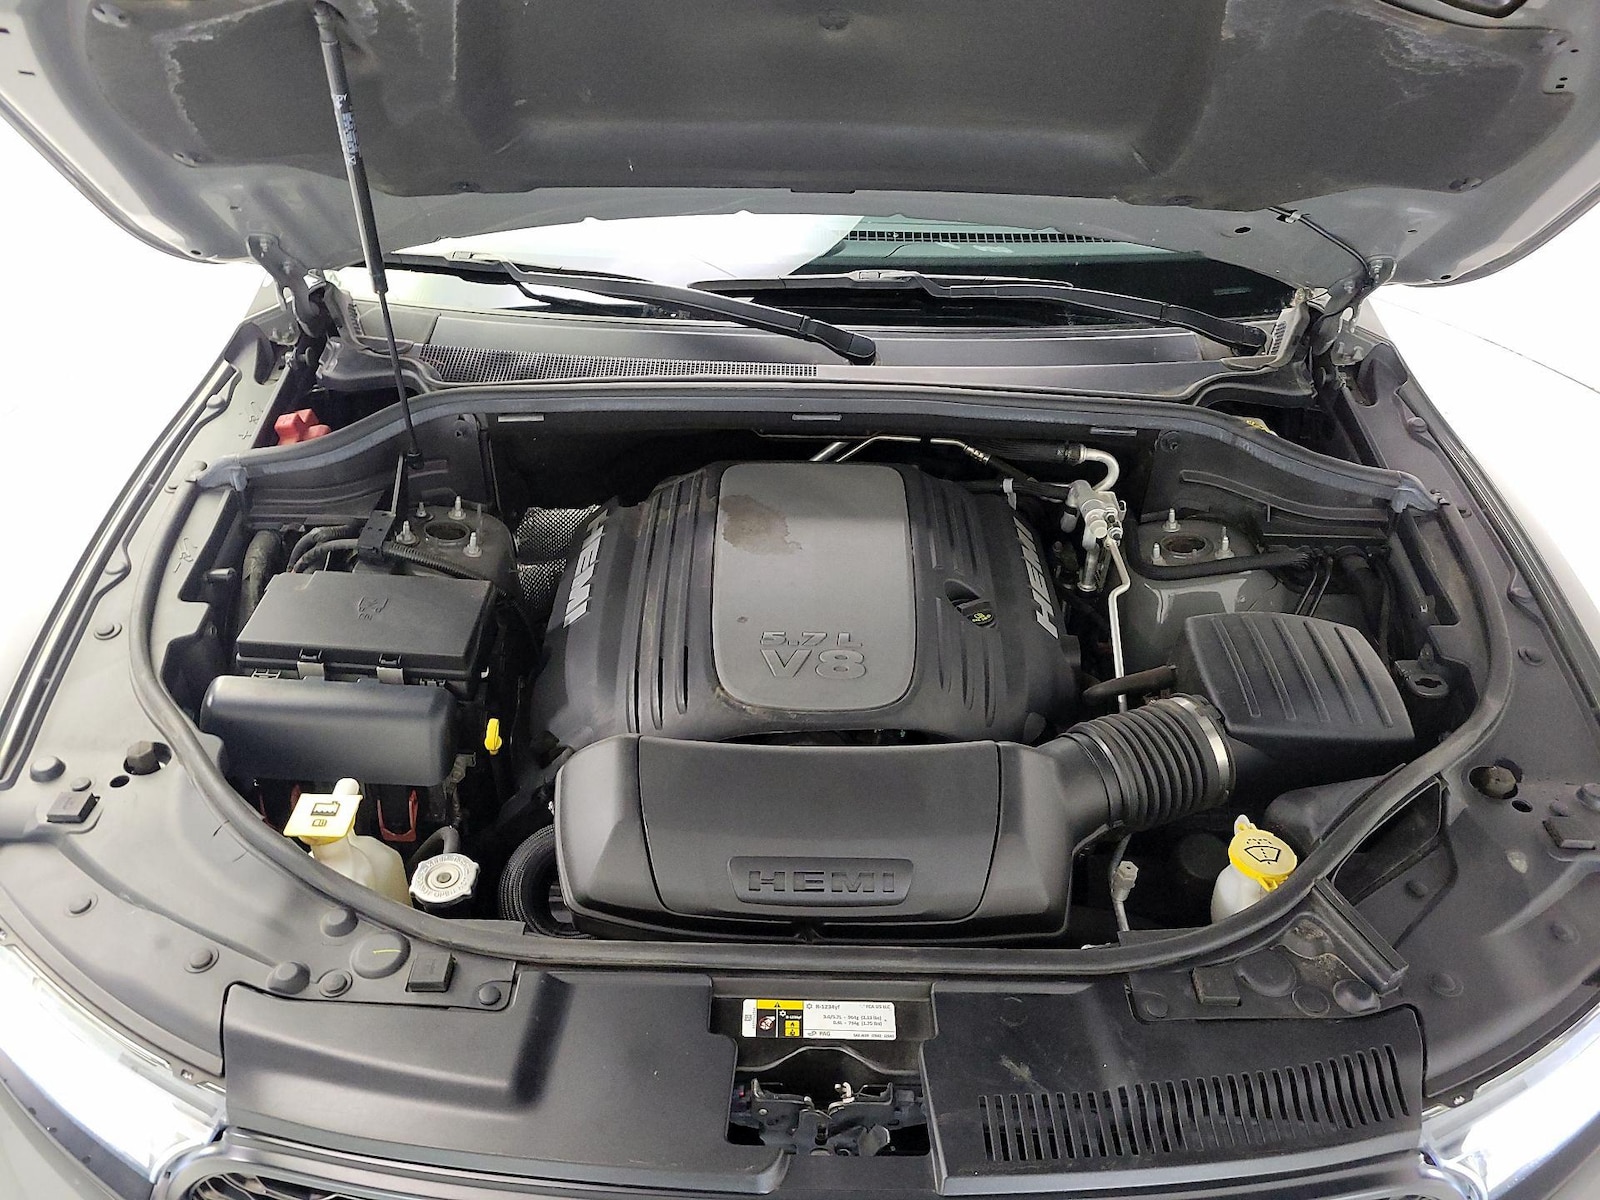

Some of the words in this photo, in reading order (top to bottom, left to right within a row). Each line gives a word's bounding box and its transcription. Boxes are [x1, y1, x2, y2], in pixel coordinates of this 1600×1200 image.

[563, 509, 608, 629] HEMI
[1013, 516, 1058, 640] HEMI
[760, 649, 867, 680] V8
[748, 871, 895, 893] HEMI
